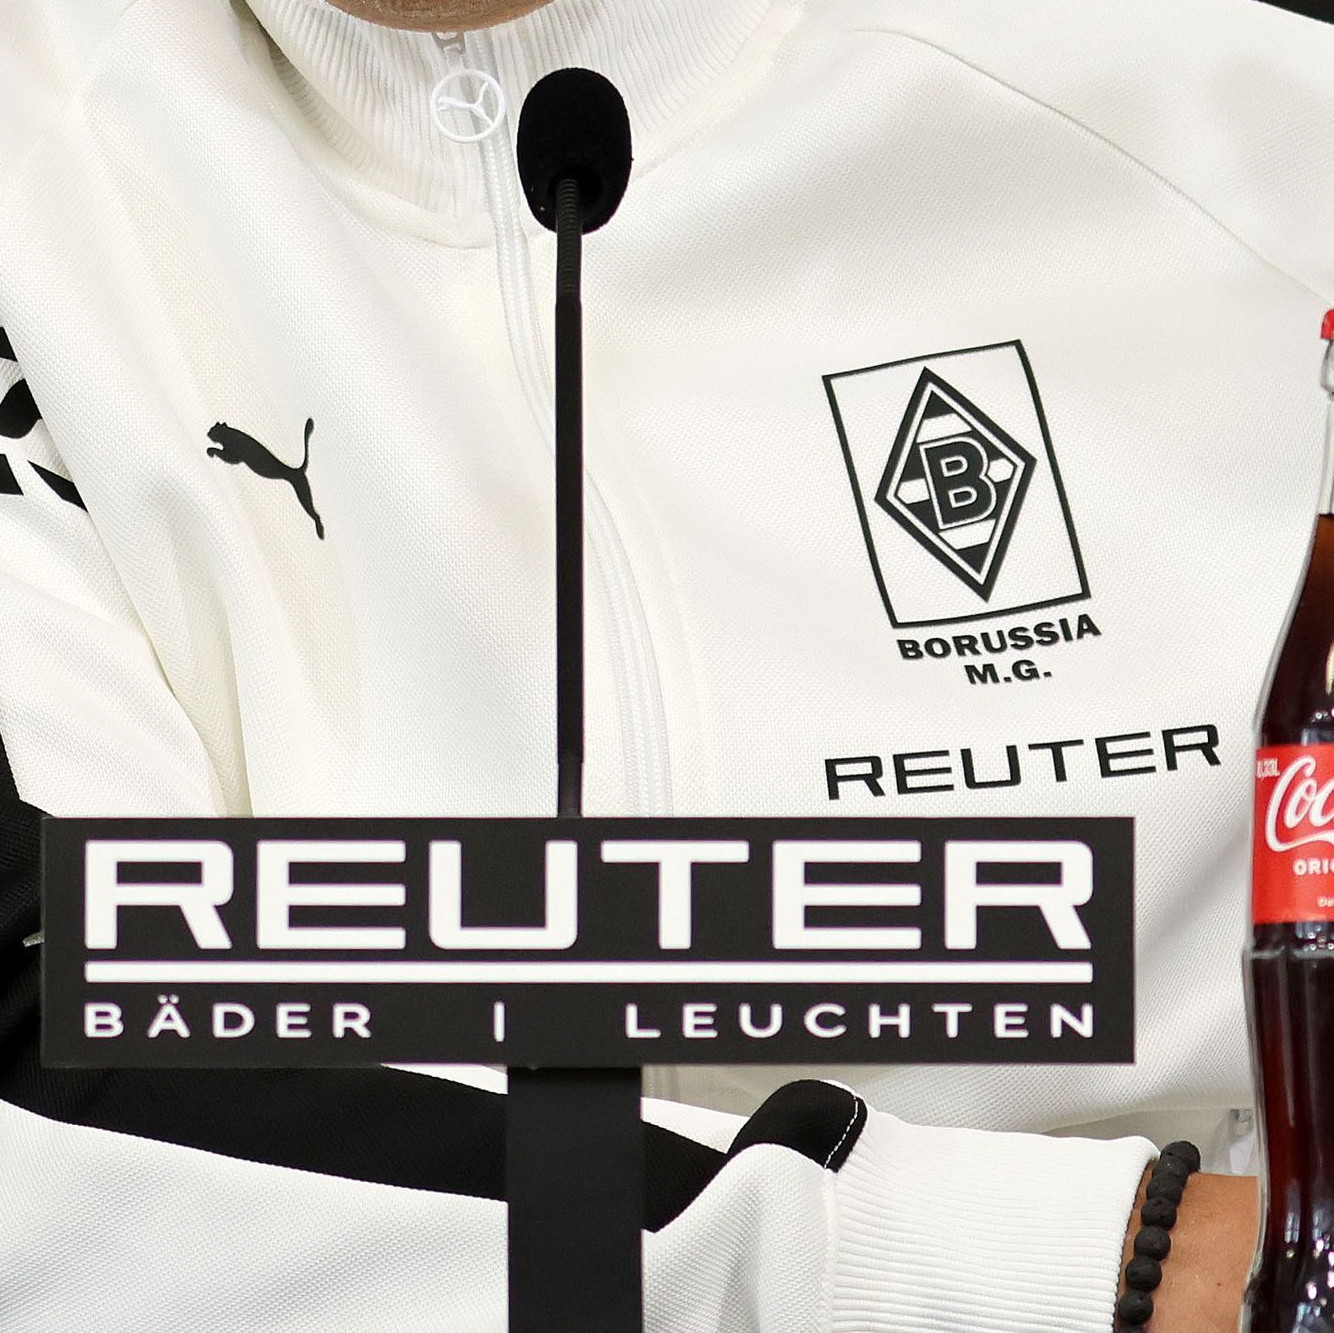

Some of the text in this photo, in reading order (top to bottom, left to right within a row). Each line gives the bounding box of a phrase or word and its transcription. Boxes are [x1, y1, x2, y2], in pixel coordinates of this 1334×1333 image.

[896, 612, 1103, 662] BORUSSIA
[963, 658, 1054, 687] M.G.
[823, 723, 1223, 802] REUTER
[83, 839, 1095, 951] REUTER
[83, 994, 373, 1041] BÄDER
[624, 1001, 1095, 1041] LEUCHTEN
